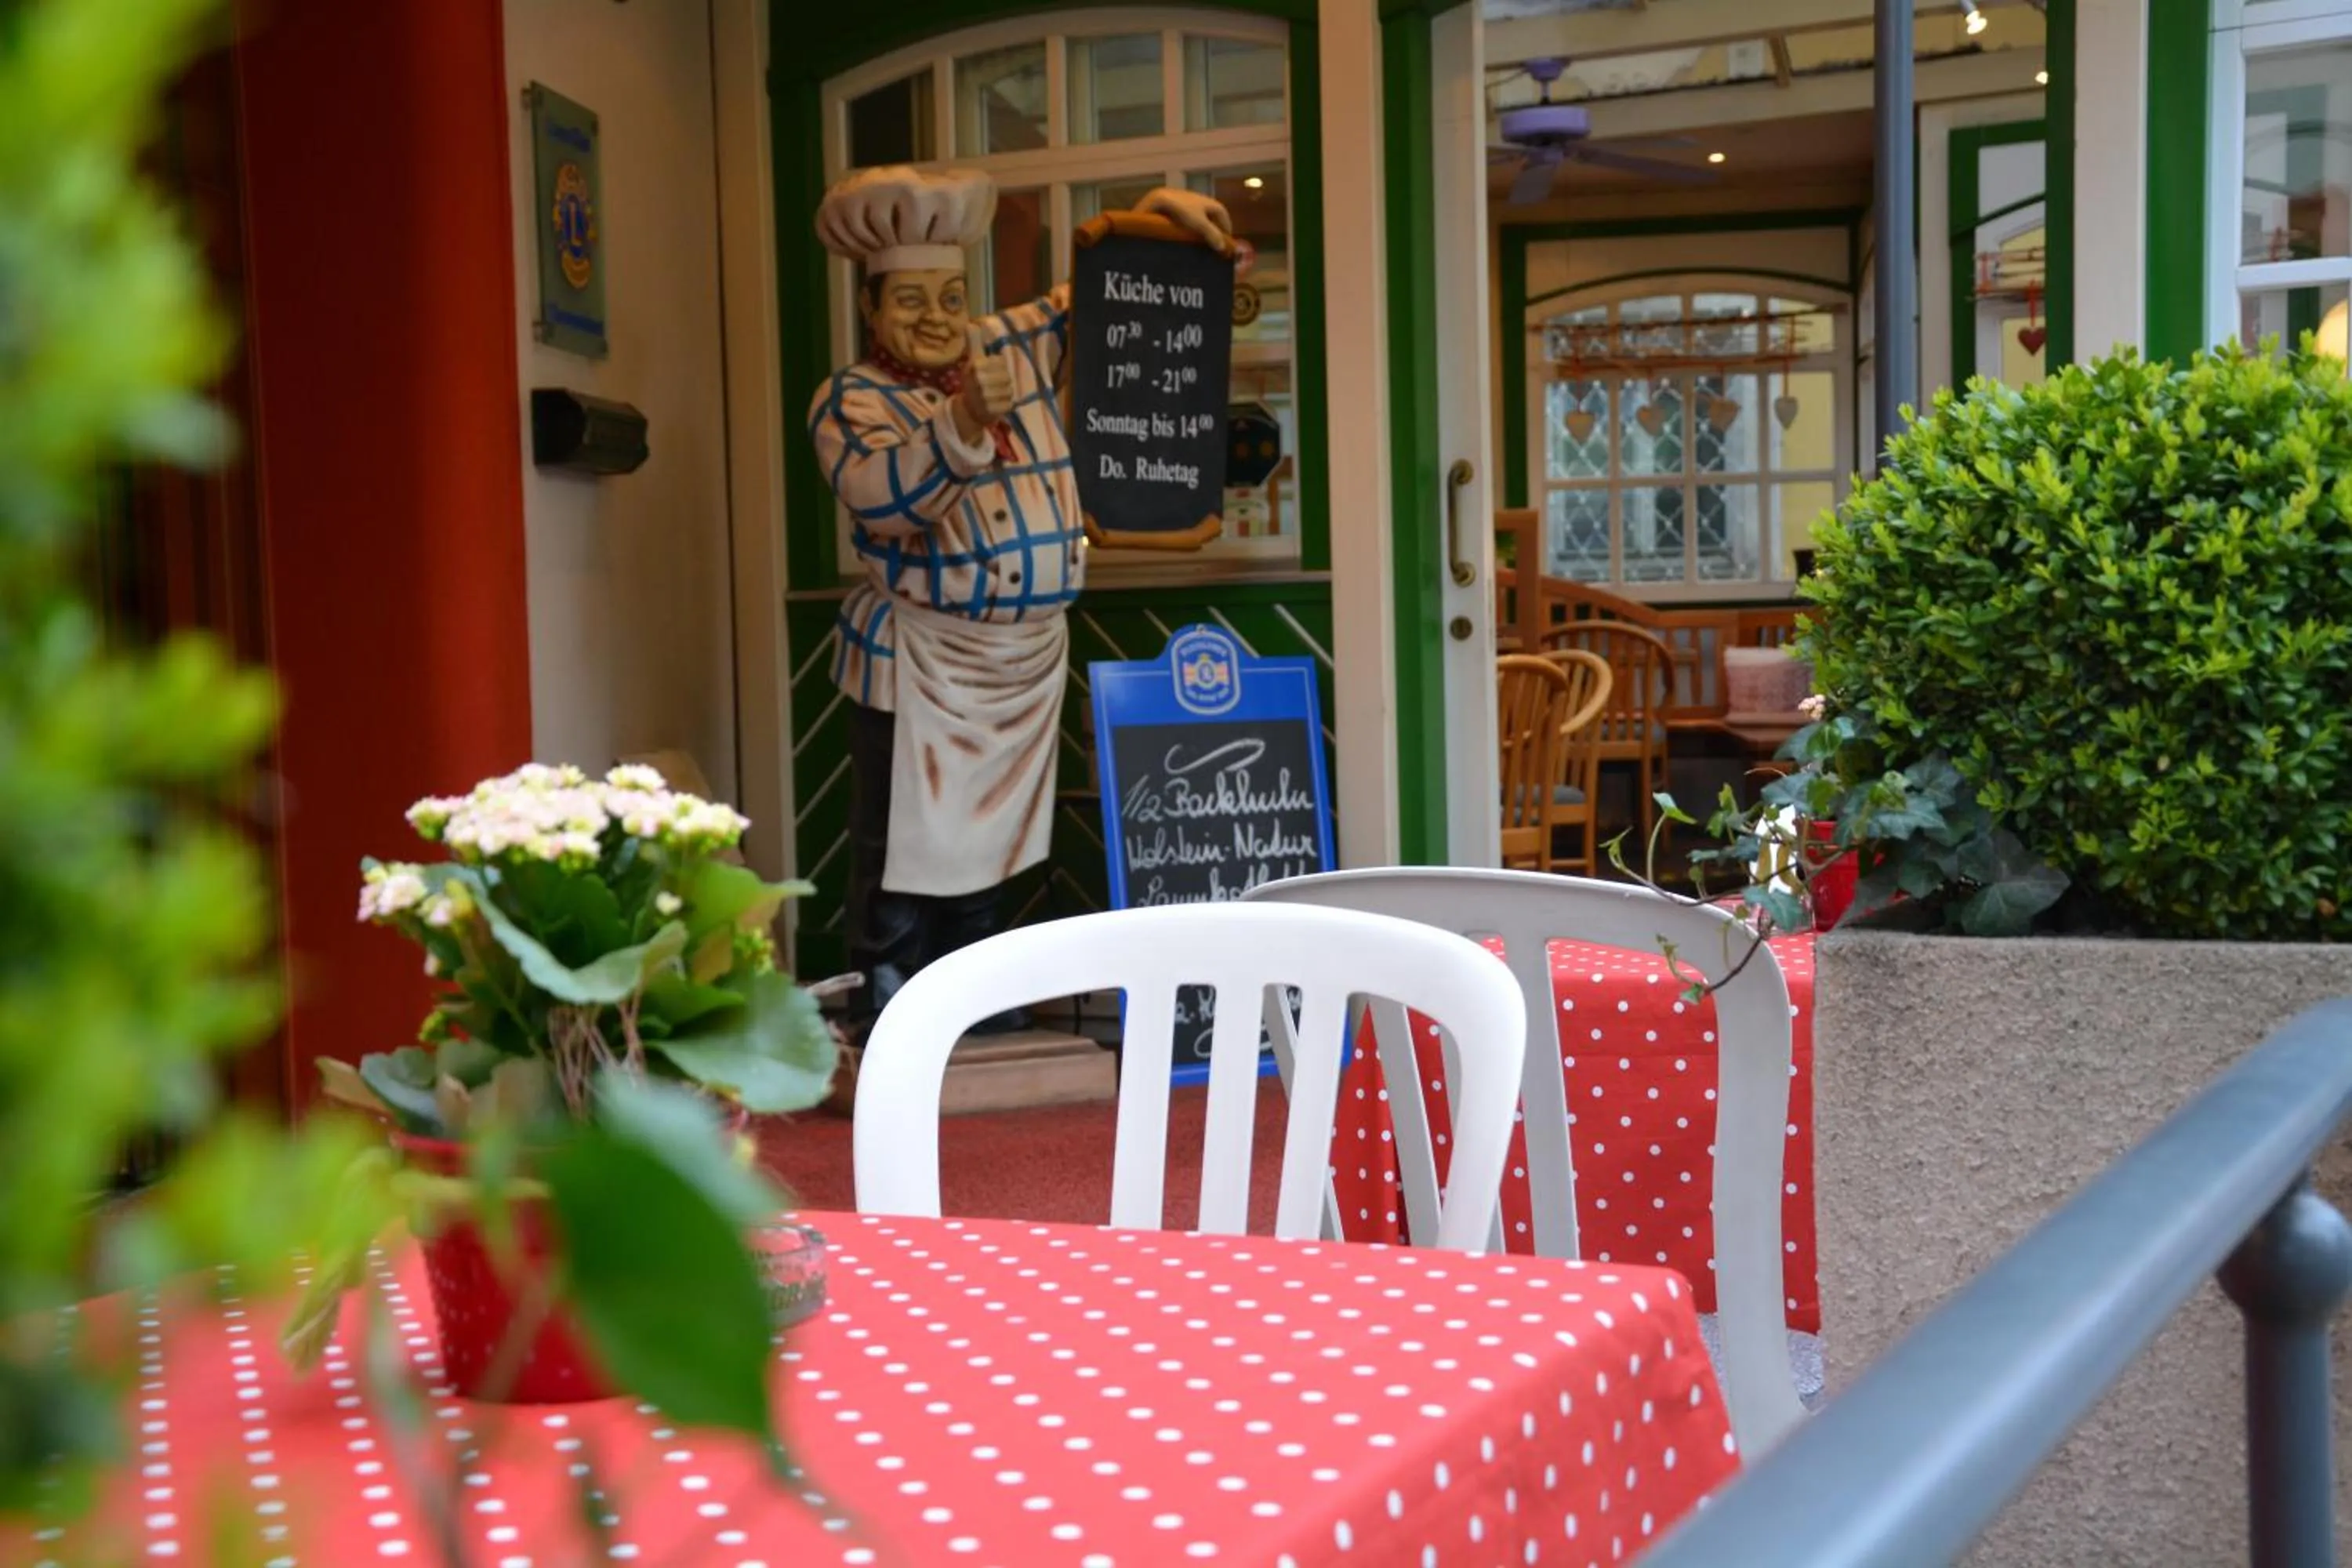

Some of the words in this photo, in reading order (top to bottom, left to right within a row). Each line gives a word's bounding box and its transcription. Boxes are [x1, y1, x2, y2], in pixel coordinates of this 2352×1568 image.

[1104, 270, 1164, 304] Küche
[1170, 285, 1203, 309] von
[1086, 408, 1149, 442] Sonntag
[1152, 412, 1175, 437] bis
[1099, 454, 1127, 479] Do.
[1136, 456, 1199, 489] Ruhetag
